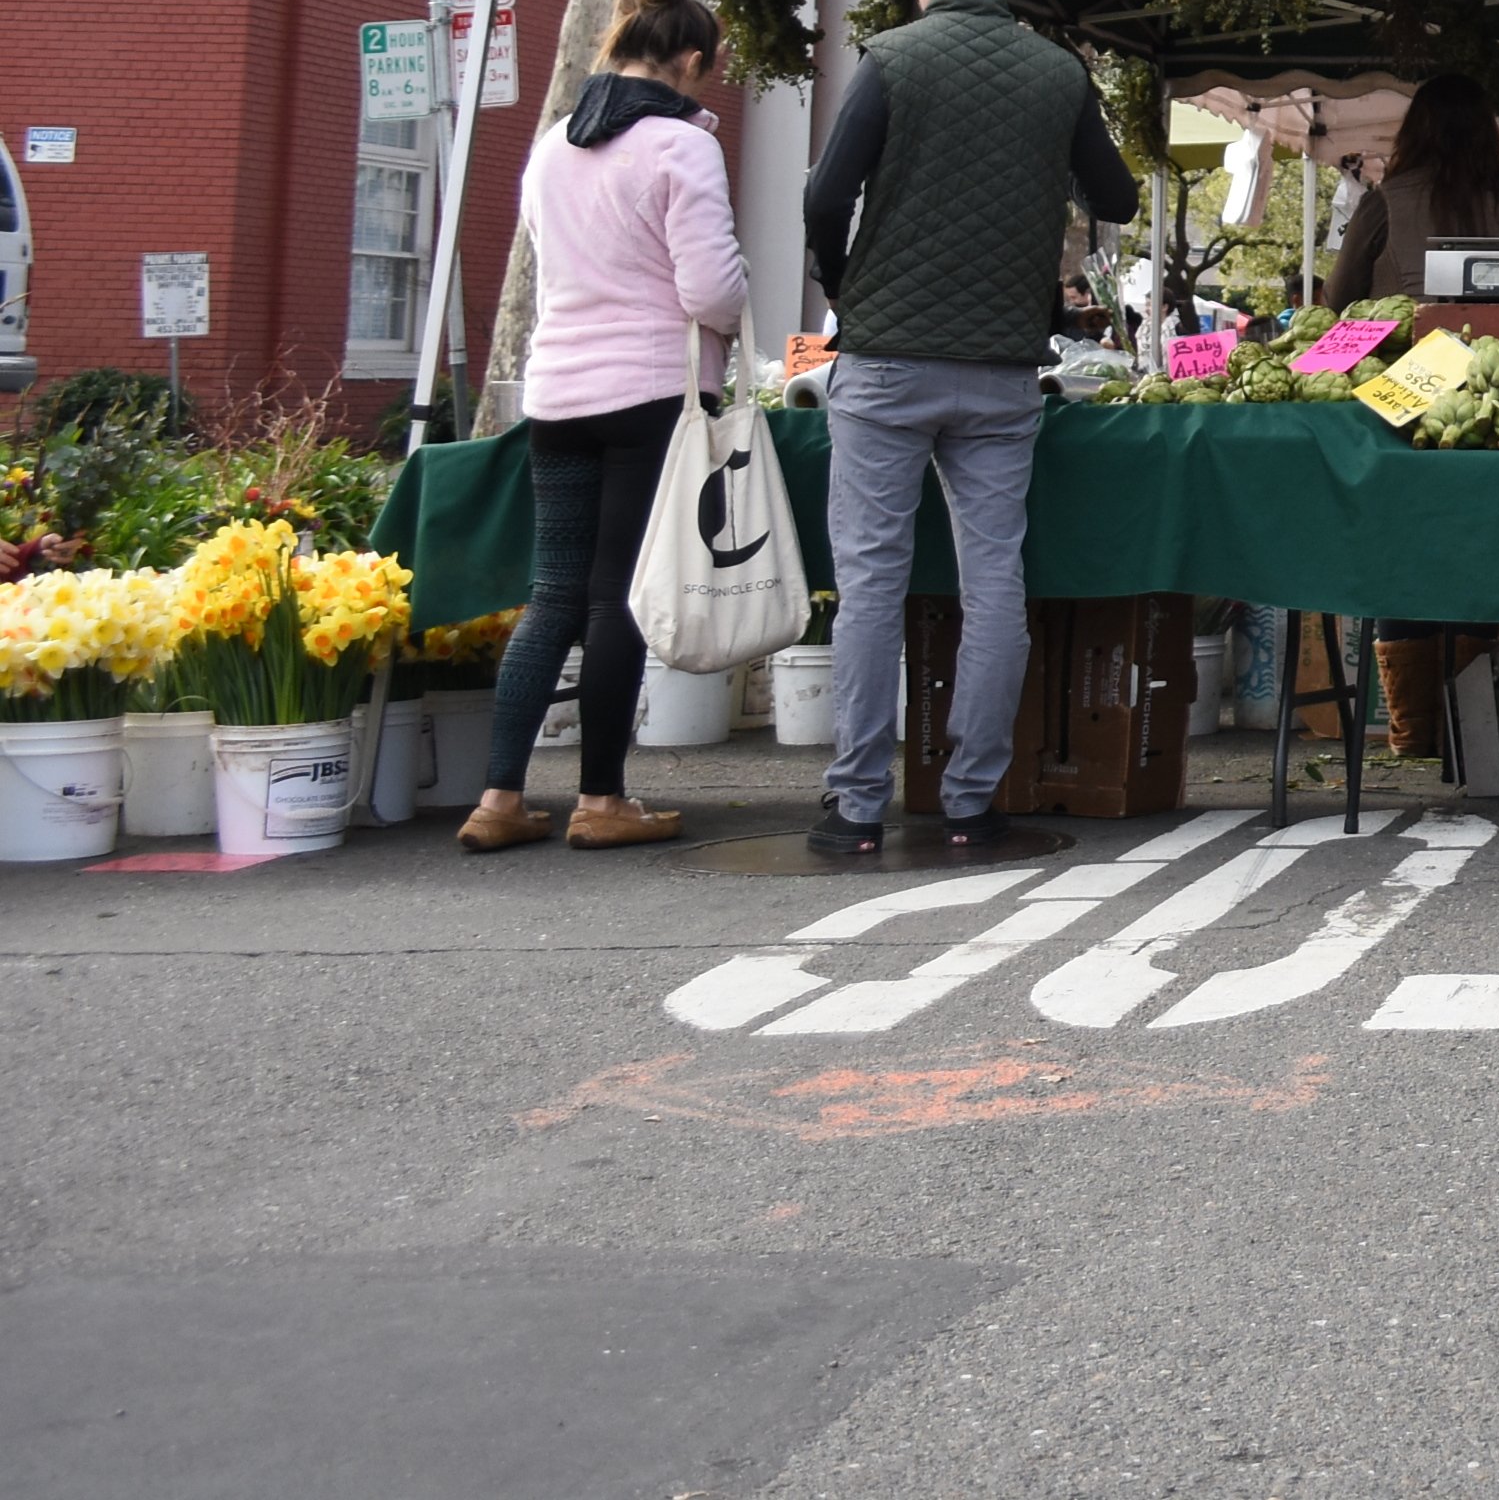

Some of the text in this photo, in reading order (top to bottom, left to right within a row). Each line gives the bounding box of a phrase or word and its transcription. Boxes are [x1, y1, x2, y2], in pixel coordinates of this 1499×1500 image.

[368, 28, 425, 50] 2 HOUR
[368, 55, 425, 75] PARKING
[31, 130, 73, 141] NOTICE
[1173, 338, 1222, 359] Baby
[1372, 390, 1412, 421] Large
